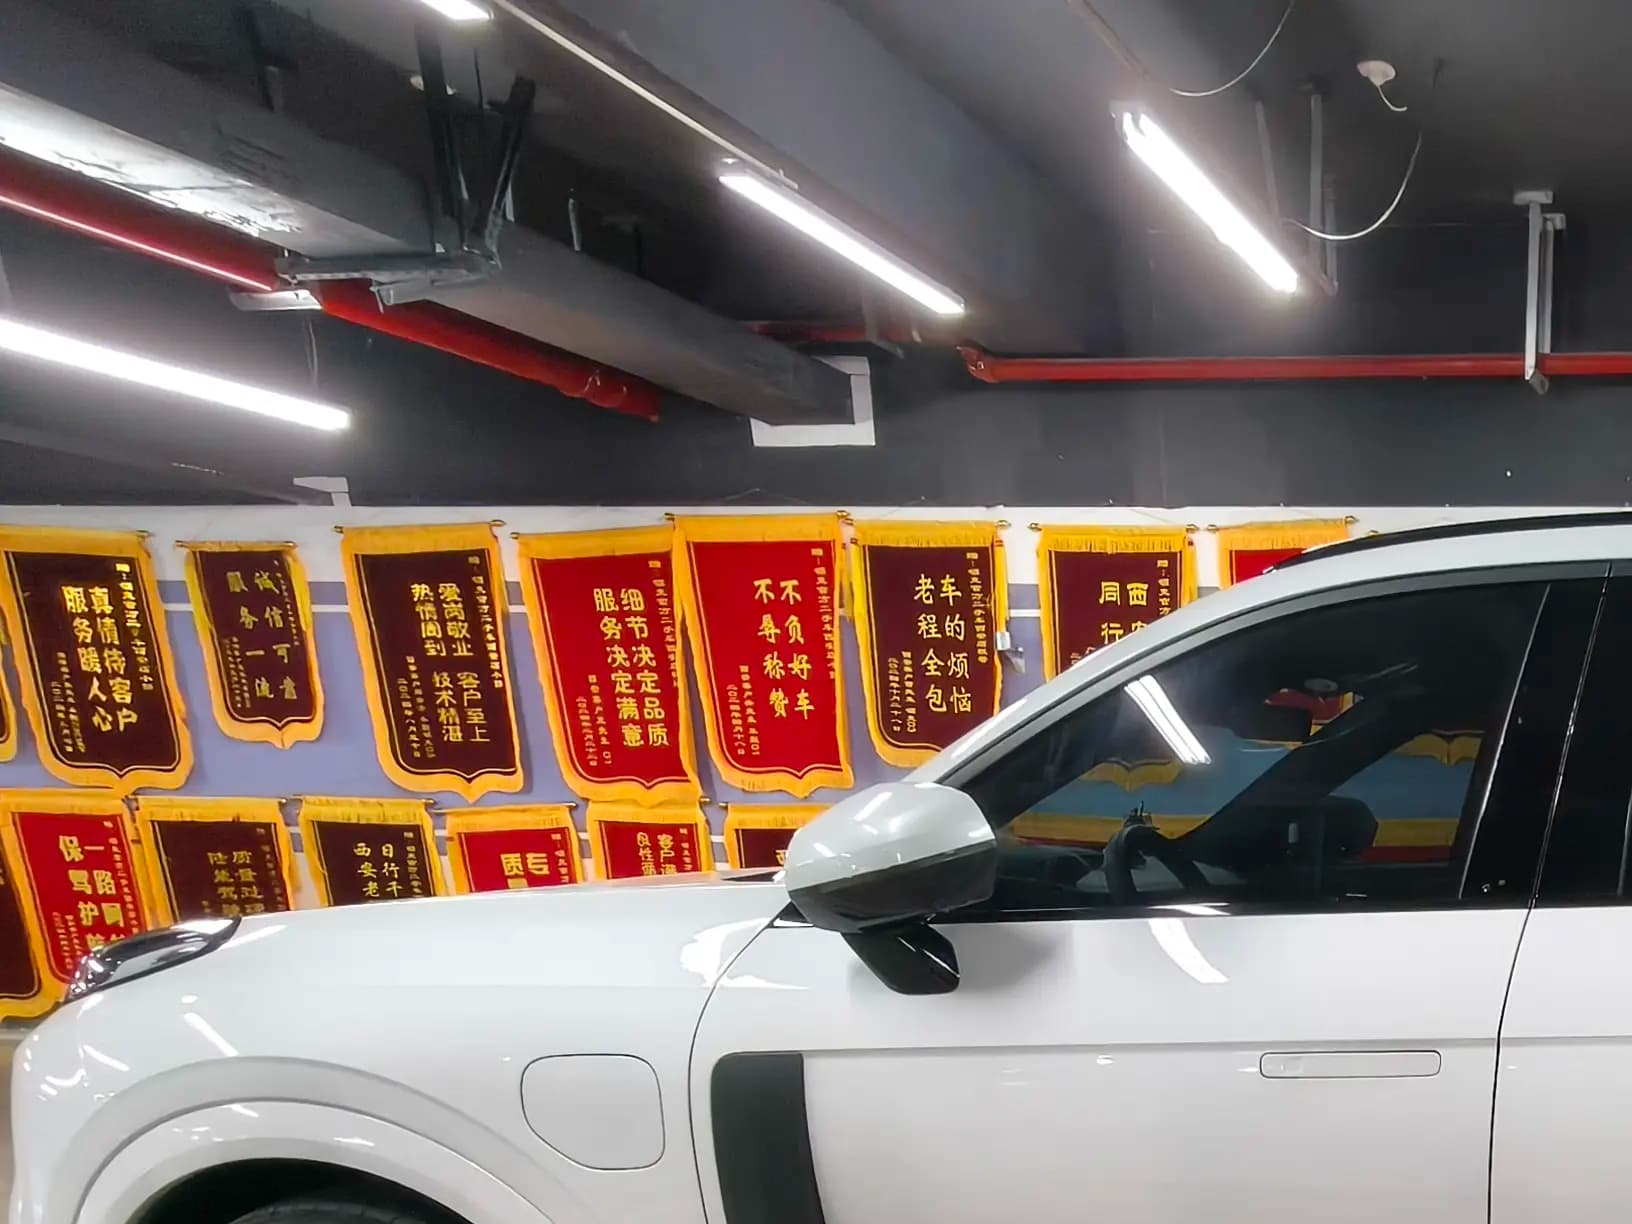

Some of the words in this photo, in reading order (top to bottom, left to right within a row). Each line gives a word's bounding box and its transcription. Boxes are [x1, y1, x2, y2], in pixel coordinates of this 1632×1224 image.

[61, 586, 113, 732] 服务暖人心
[89, 586, 138, 732] 真情待客户
[226, 570, 275, 699] 服务一流
[253, 570, 297, 699] 诚信可靠
[410, 583, 447, 656] 热情周到
[432, 671, 464, 742] 技术精湛
[438, 582, 474, 656] 爱岗敬业
[456, 671, 490, 742] 客户至上
[593, 587, 646, 748] 服务决定满意
[619, 587, 670, 747] 细节决定品质
[779, 578, 815, 720] 不负好车
[914, 573, 948, 713] 老程全包
[939, 574, 973, 714] 车的烦恼
[1098, 581, 1124, 644] 同行
